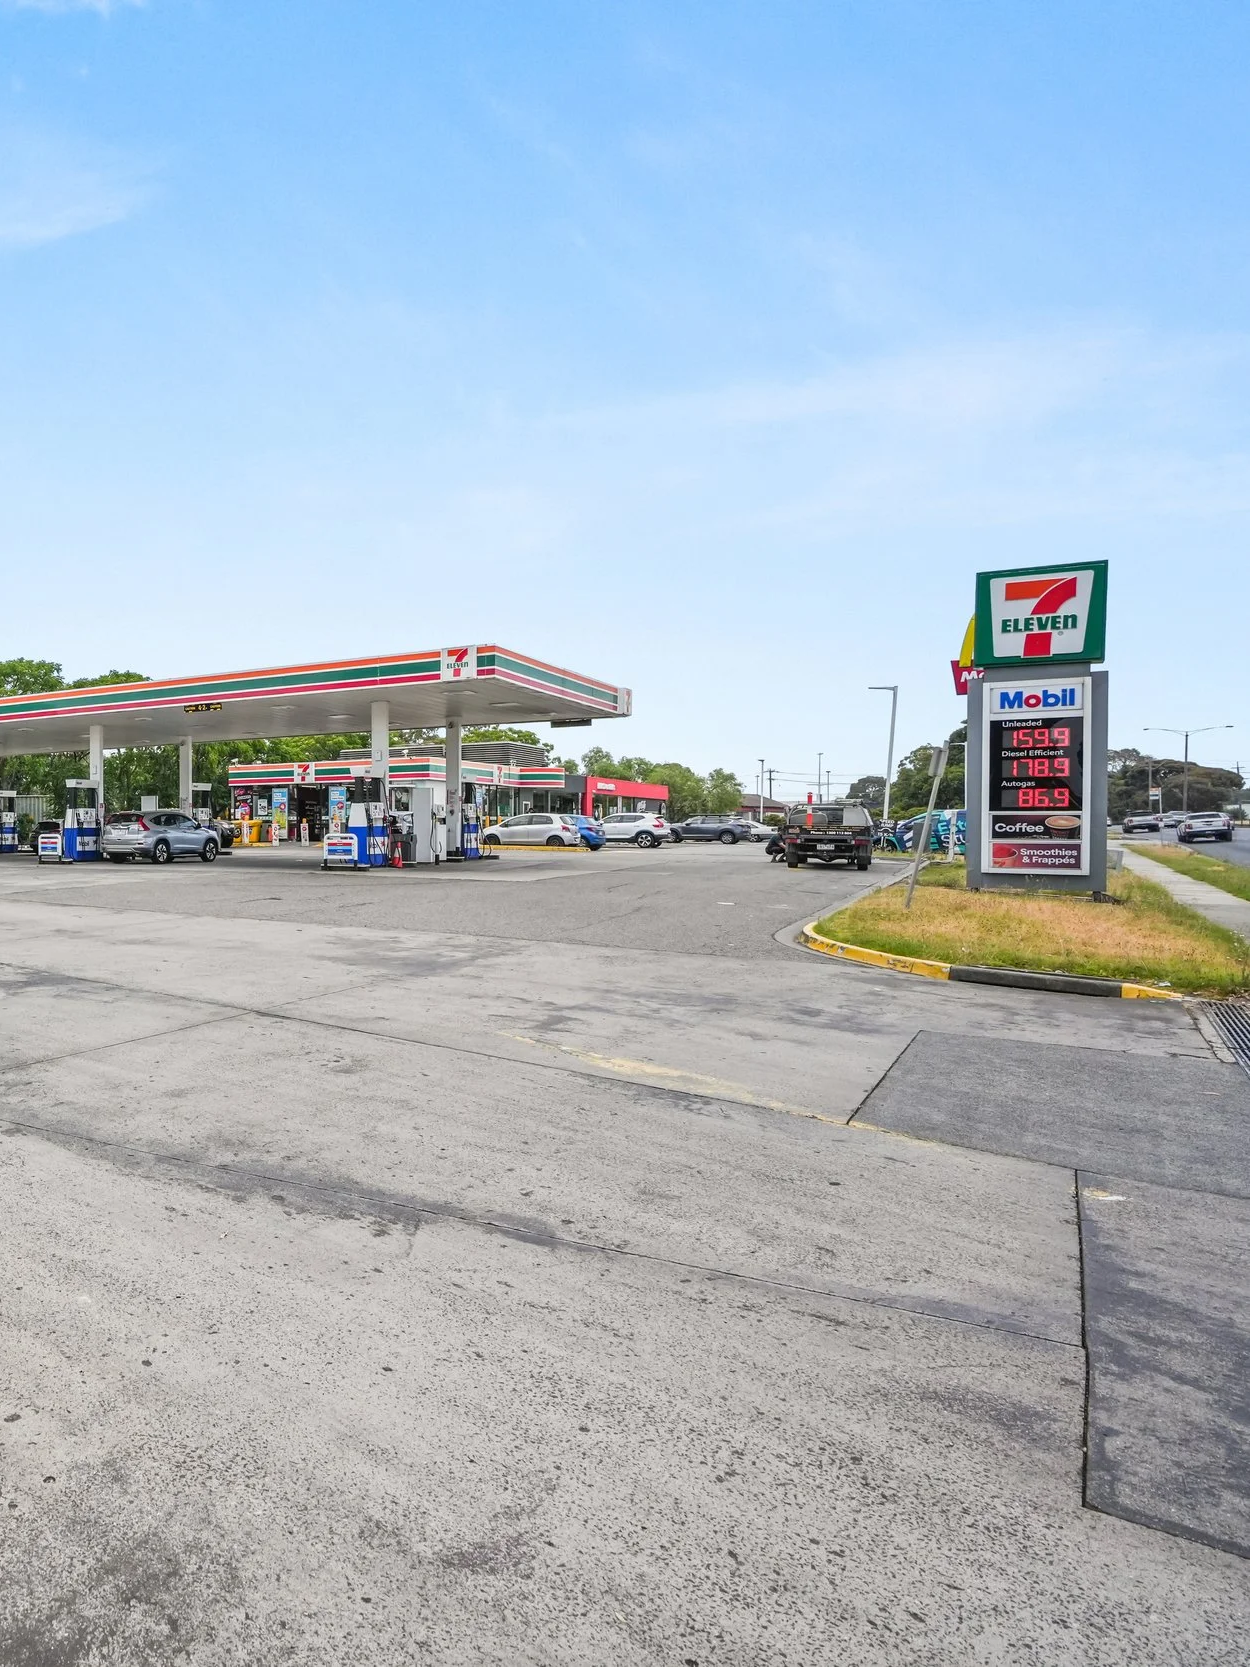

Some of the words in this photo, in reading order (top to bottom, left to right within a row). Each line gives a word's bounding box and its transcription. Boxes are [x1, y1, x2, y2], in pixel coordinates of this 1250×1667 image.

[1005, 577, 1077, 657] 7
[1000, 688, 1075, 709] Mobil
[1002, 720, 1042, 728] Unleaded
[1013, 728, 1069, 748] 159.9
[1029, 749, 1064, 757] Efficient
[1012, 758, 1069, 777] 178.9
[1001, 780, 1036, 788] Autogas
[1018, 788, 1069, 808] 86.9
[994, 823, 1044, 833] Coffee
[1020, 848, 1078, 856] Smoothies
[1032, 856, 1076, 865] Frappés
